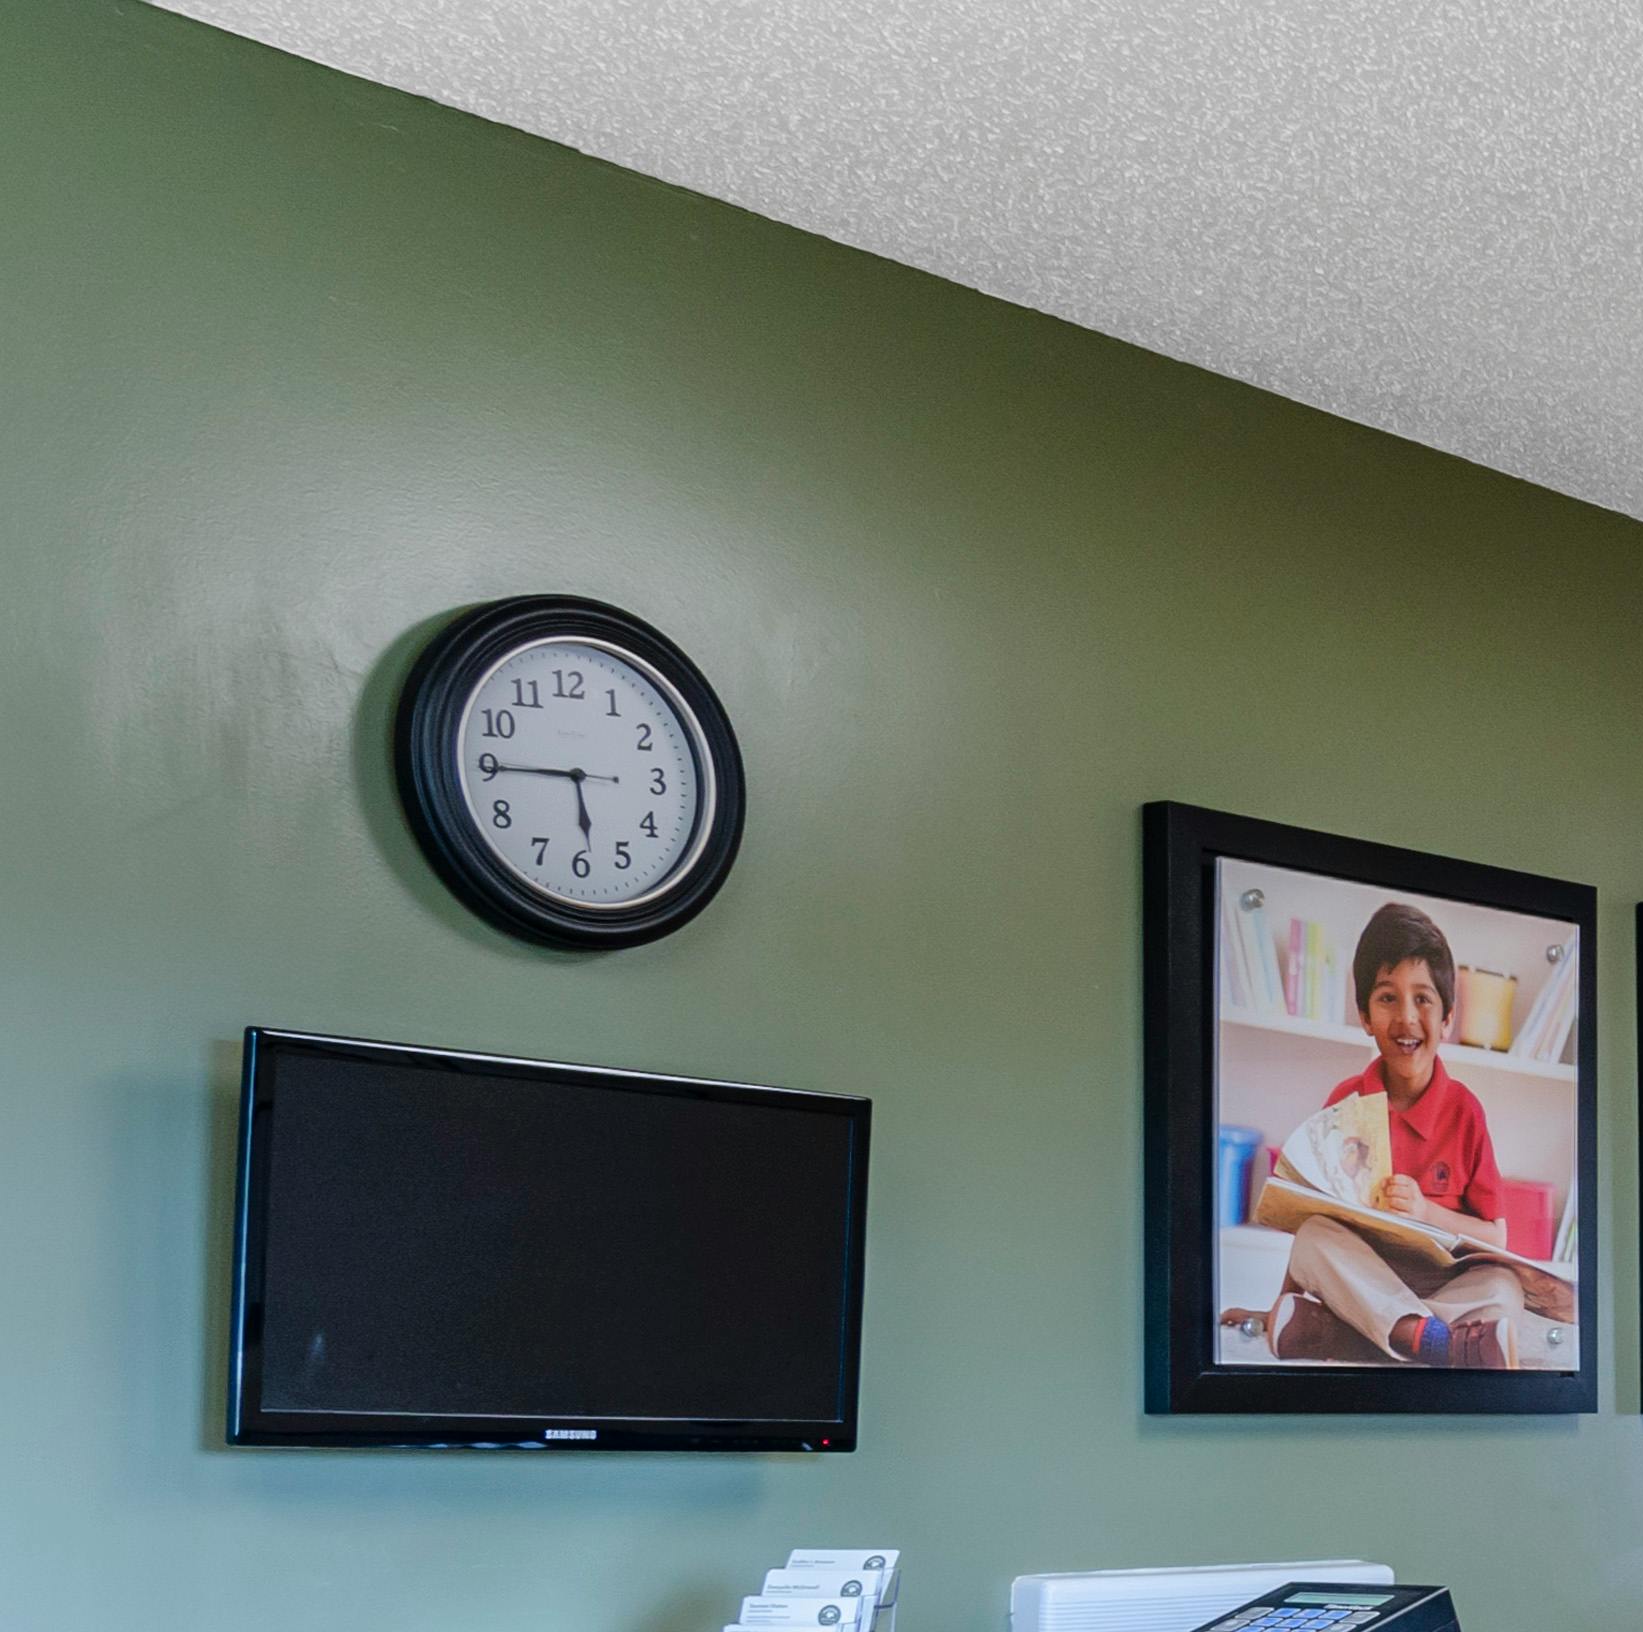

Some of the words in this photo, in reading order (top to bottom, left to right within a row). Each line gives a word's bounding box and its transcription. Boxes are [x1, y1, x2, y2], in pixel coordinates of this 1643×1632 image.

[511, 678, 544, 709] 11
[552, 670, 585, 700] 12
[605, 689, 621, 717] 1
[482, 709, 515, 739] 10
[636, 723, 653, 751] 2
[478, 753, 498, 781] 9
[650, 768, 666, 795] 3
[493, 800, 512, 828] 8
[640, 811, 658, 838] 4
[531, 837, 550, 866] 7
[572, 850, 590, 878] 6
[614, 841, 631, 869] 5
[545, 1429, 597, 1440] SAMSUNG
